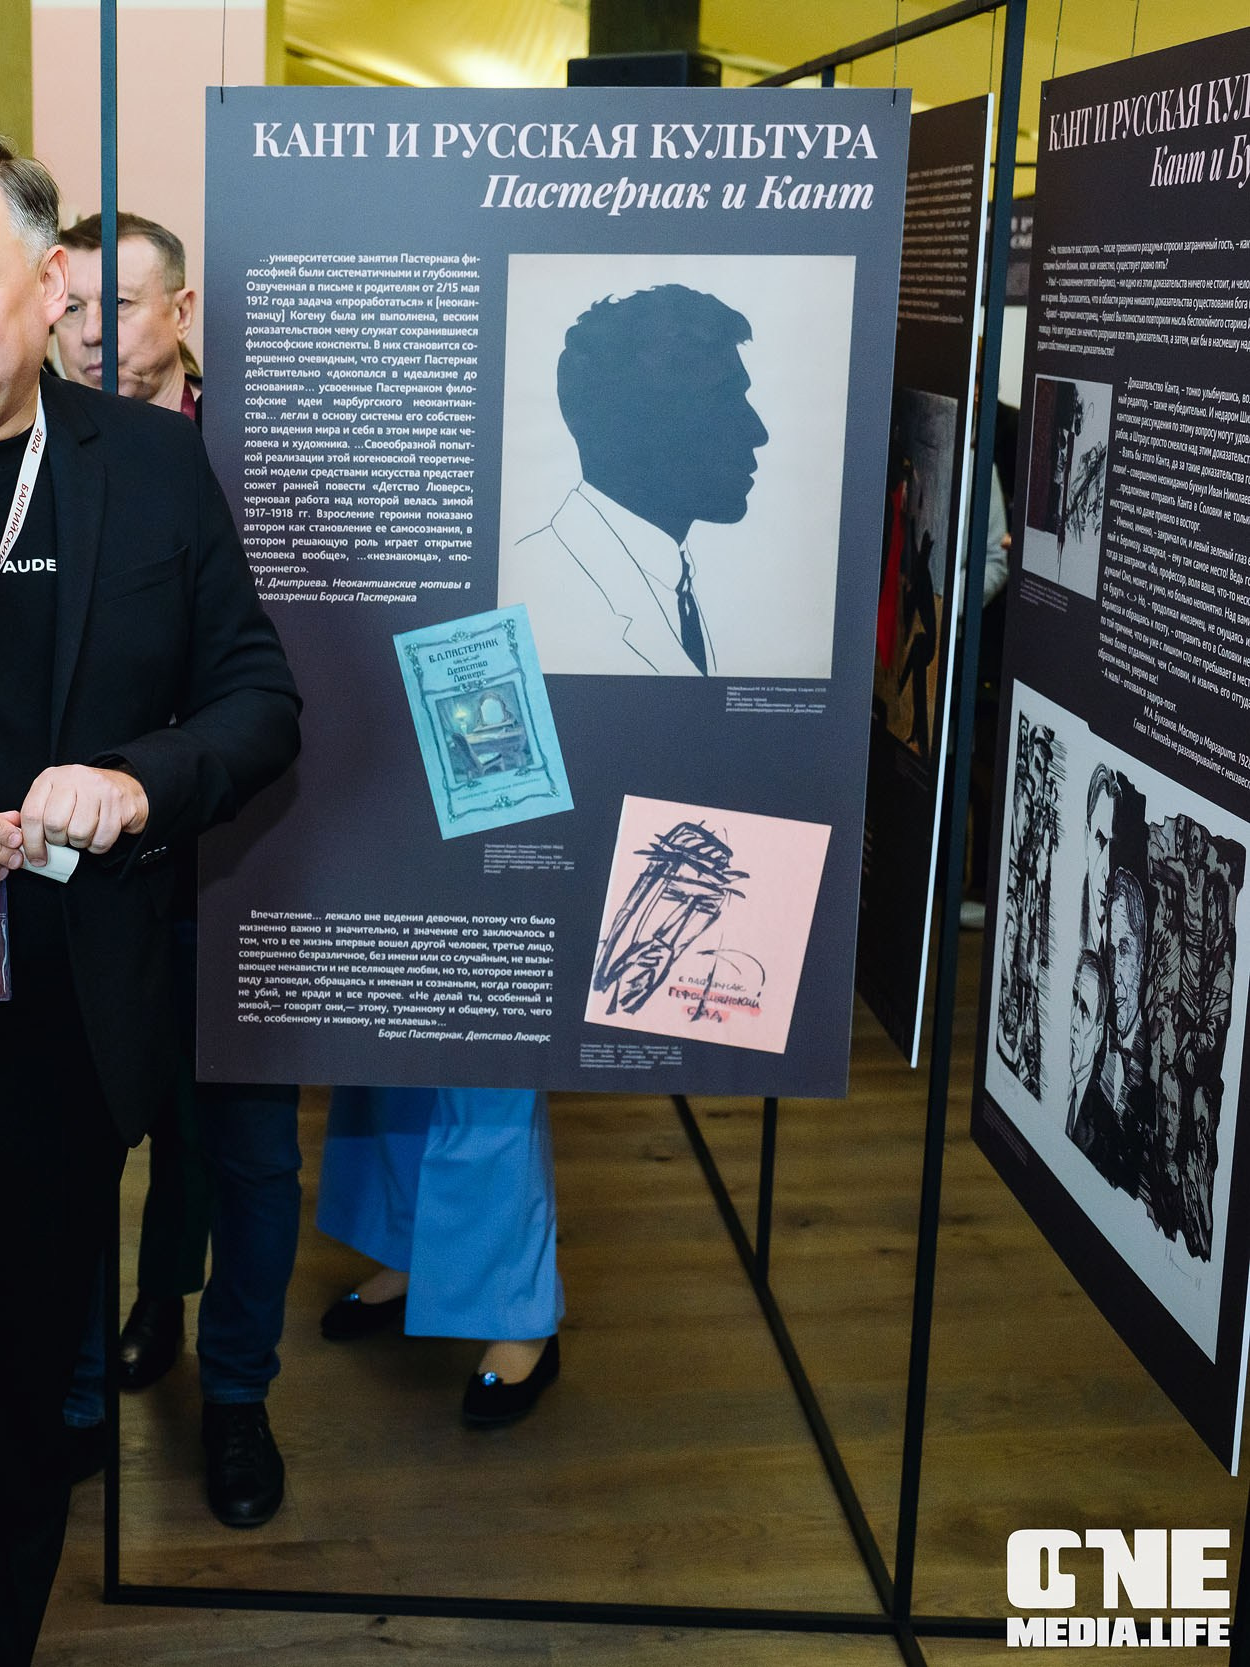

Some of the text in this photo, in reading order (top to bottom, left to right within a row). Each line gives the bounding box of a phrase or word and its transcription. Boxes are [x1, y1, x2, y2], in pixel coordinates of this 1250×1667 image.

[1048, 108, 1091, 152] КАНТ
[1094, 103, 1109, 144] И
[1111, 83, 1202, 141] РУССКАЯ
[252, 122, 879, 160] КАНТ И РУССКАЯ КУЛЬТУРА
[1150, 146, 1205, 187] Кант
[1209, 148, 1224, 182] и
[480, 174, 874, 216] Пастернак и Кант
[357, 254, 398, 263] занятия
[400, 252, 460, 266] Пастернака
[461, 252, 480, 266] фи-
[245, 266, 296, 279] лософией
[298, 266, 324, 277] были
[326, 269, 412, 277] систематичными
[422, 267, 480, 280] глубокими.
[245, 294, 268, 305] 1912
[271, 297, 295, 308] года
[298, 297, 332, 308] задача
[335, 295, 424, 309] «проработаться»
[435, 296, 479, 309] [неокан-
[244, 326, 478, 338] доказательством чему служат сохранившиеся
[245, 353, 478, 367] вершенно очевидным, что студент Пастернак
[318, 383, 372, 395] усвоенные
[376, 381, 442, 395] Пастернаком
[445, 382, 476, 396] фило-
[244, 394, 476, 409] софские идеи марбургского неокантиан-
[31, 428, 43, 454] 2024
[244, 439, 279, 448] ловека
[292, 440, 350, 451] художника.
[439, 441, 475, 450] попыт-
[244, 464, 474, 480] ской модели средствами искусства предстает
[298, 509, 310, 518] гг.
[316, 507, 374, 521] Взросление
[379, 510, 421, 522] героини
[426, 511, 473, 520] показано
[243, 537, 472, 550] котором решающую роль играет открытие
[2, 558, 57, 574] AUDE
[254, 575, 264, 586] Н.
[267, 576, 328, 590] Дмитриева.
[332, 577, 416, 589] Неокантианские
[418, 580, 462, 589] мотивы
[324, 912, 361, 920] лежало
[363, 913, 381, 921] вне
[383, 913, 424, 924] ведения
[471, 915, 508, 926] потому
[510, 916, 528, 924] что
[529, 914, 556, 924] было
[238, 949, 297, 961] совершенно
[369, 950, 386, 960] без
[387, 953, 418, 961] имени
[420, 953, 438, 961] или
[439, 954, 452, 962] со
[510, 955, 523, 963] не
[238, 975, 262, 986] виду
[313, 975, 366, 988] обращаясь
[376, 979, 414, 987] именам
[480, 981, 509, 992] когда
[378, 1029, 552, 1044] Борис Пастернак. Детство Люверс
